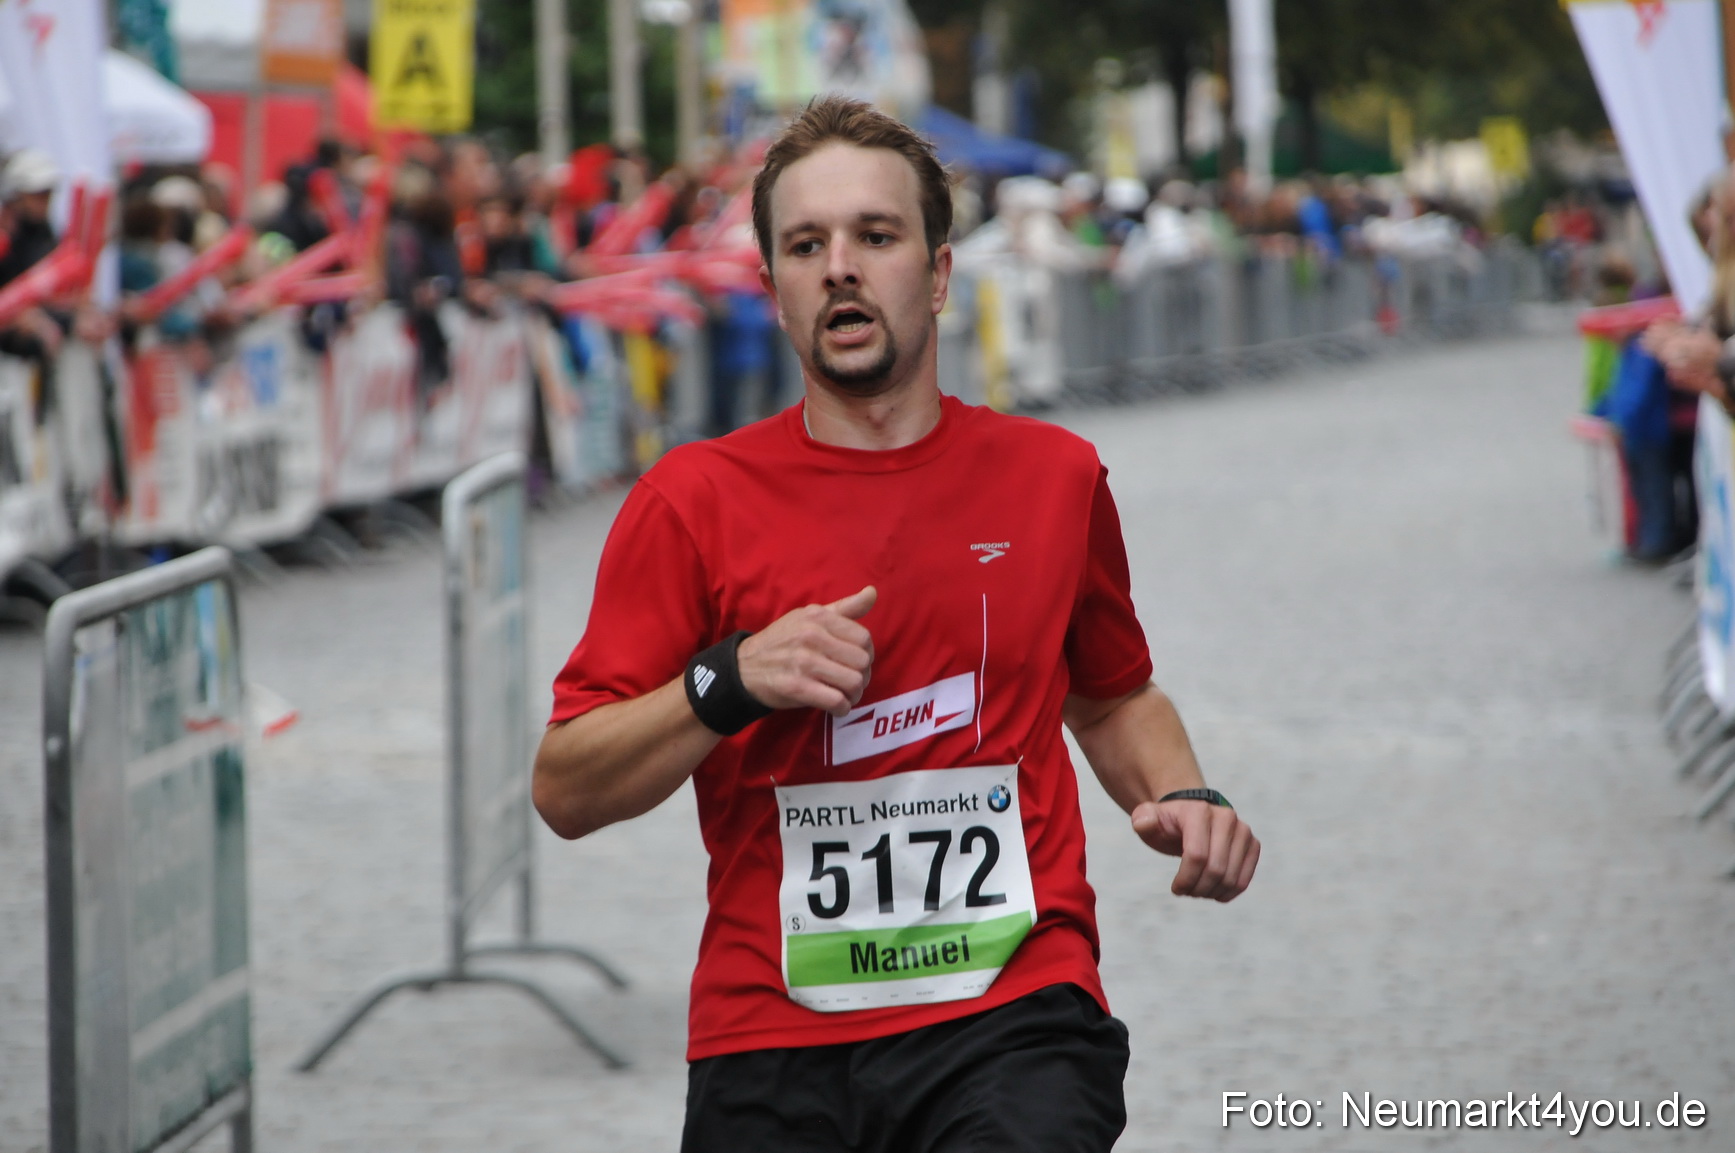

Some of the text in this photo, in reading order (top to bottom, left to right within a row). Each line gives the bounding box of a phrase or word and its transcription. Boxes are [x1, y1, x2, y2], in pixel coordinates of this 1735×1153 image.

[394, 31, 446, 88] A
[970, 541, 1010, 550] BROOKS
[872, 699, 934, 740] DEHN
[785, 793, 979, 827] PARTL Neumarkt
[807, 825, 1007, 919] 5172
[791, 917, 801, 931] S
[850, 935, 970, 975] Manuel
